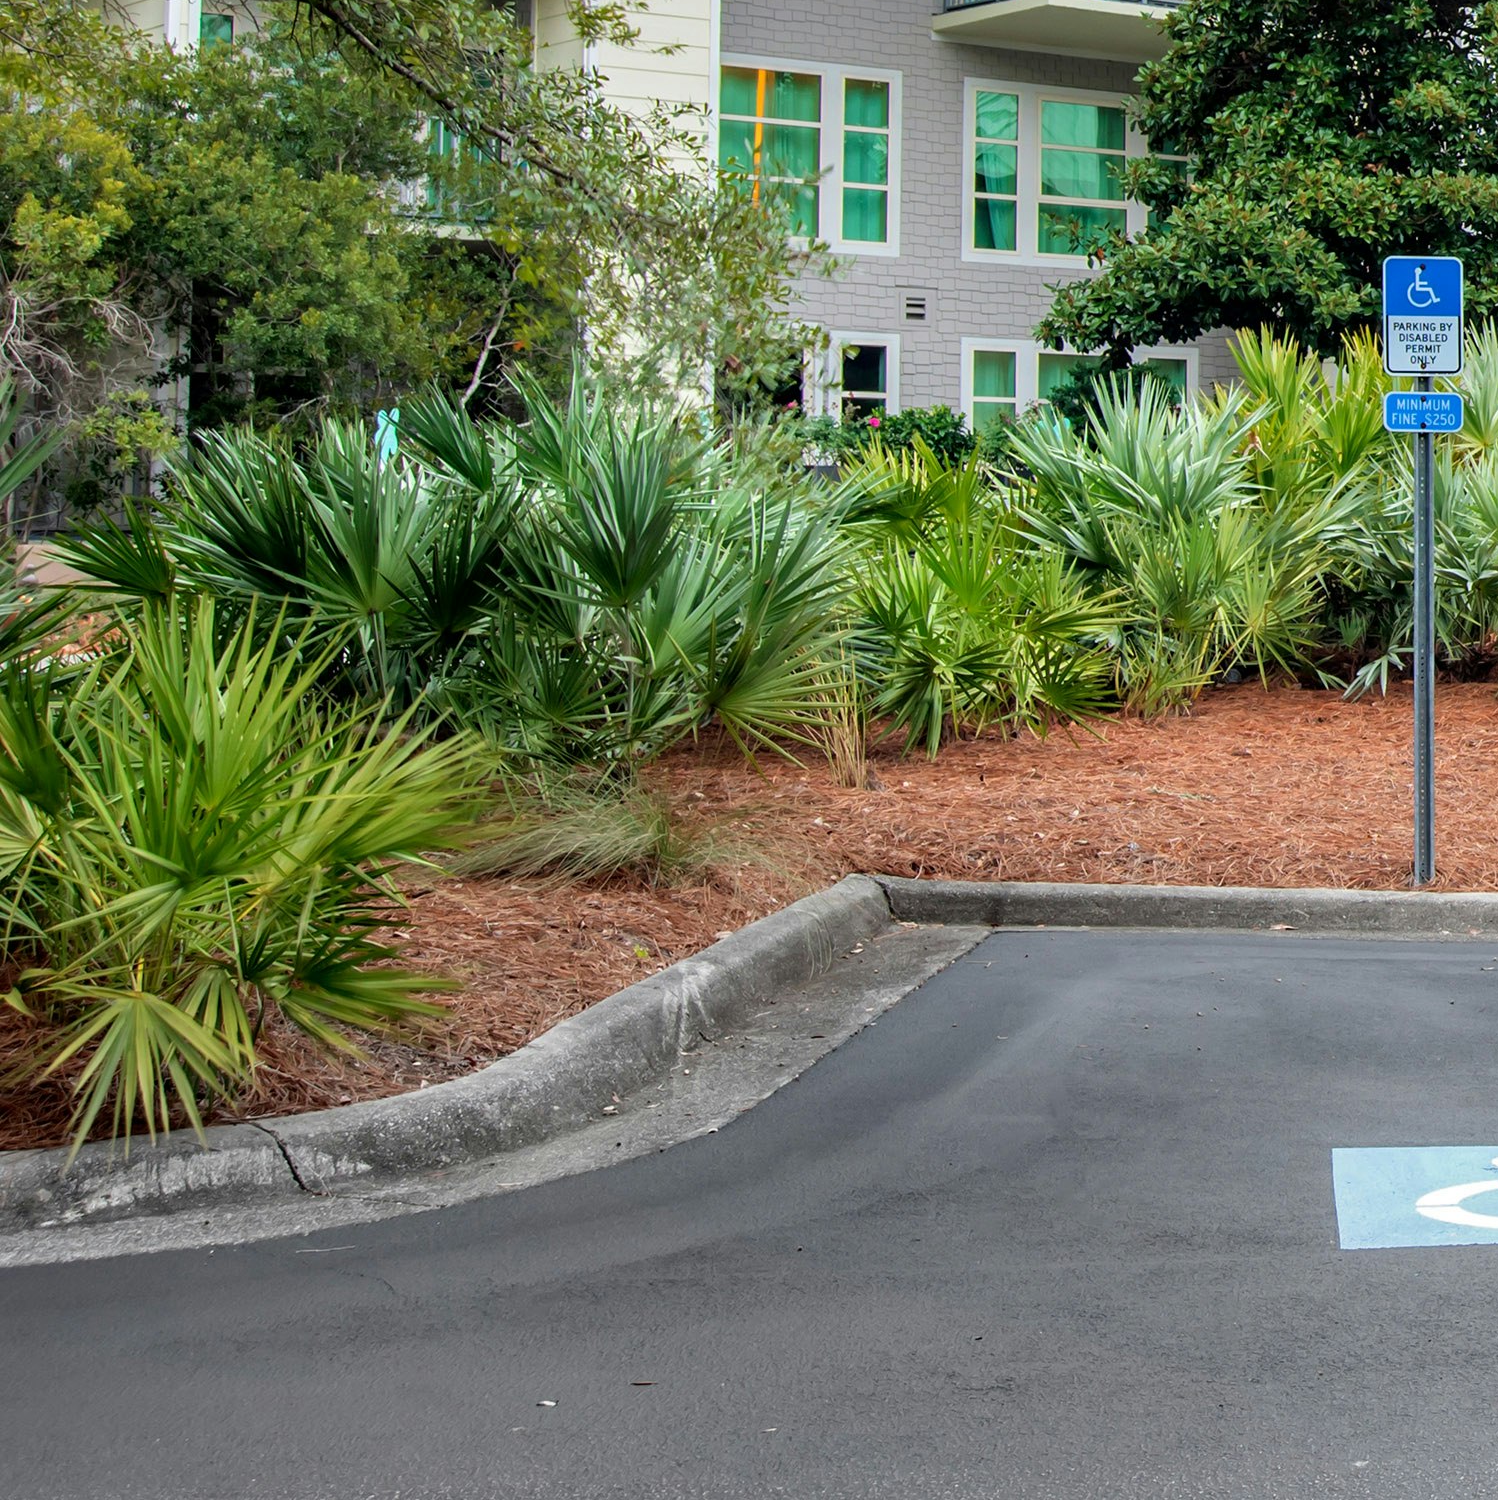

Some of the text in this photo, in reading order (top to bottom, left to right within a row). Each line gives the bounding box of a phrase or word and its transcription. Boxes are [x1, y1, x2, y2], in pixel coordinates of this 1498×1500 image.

[1393, 322, 1453, 331] PARKING BY
[1399, 333, 1448, 342] DISABLED
[1405, 344, 1441, 353] PERMIT
[1410, 355, 1437, 364] ONLY
[1396, 399, 1450, 411] MINIMUM
[1392, 412, 1456, 426] FINE $250
